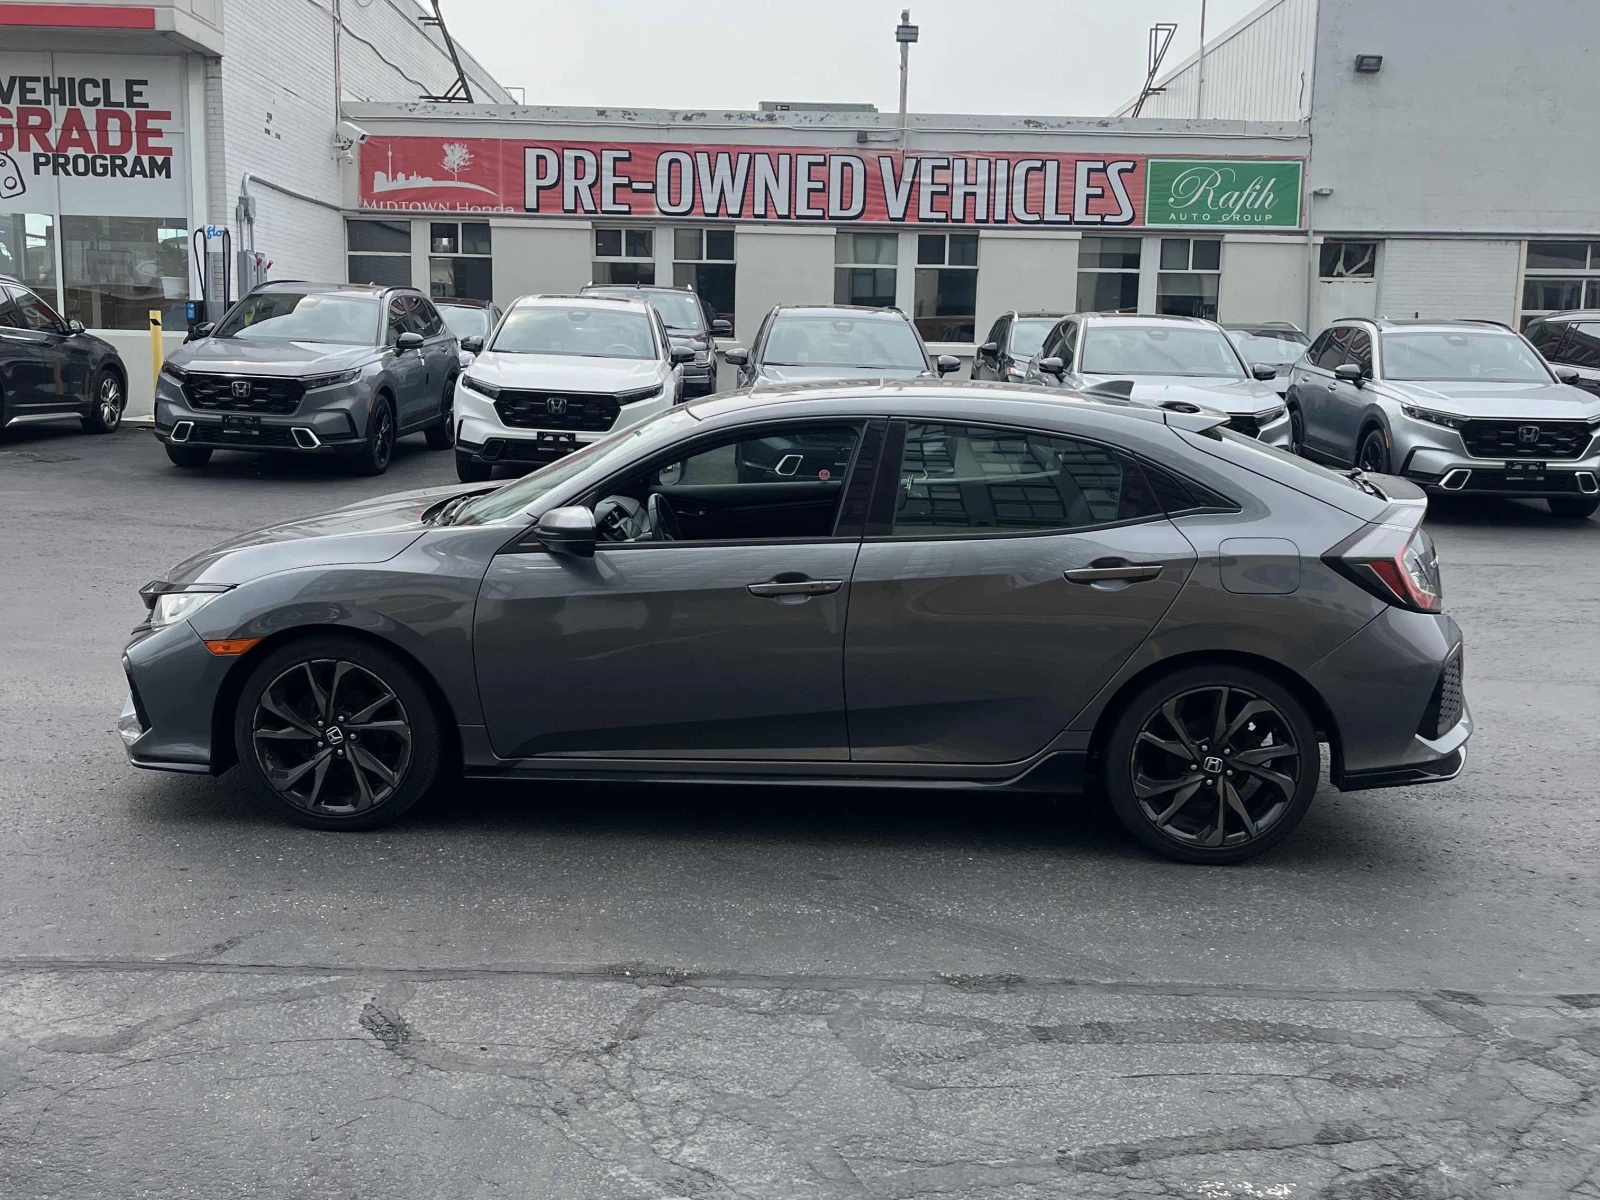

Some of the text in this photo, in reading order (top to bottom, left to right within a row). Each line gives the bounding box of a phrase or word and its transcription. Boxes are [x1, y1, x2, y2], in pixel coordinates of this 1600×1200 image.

[0, 76, 149, 108] VEHICLE
[33, 152, 172, 179] PROGRAM
[523, 146, 1137, 225] PRE-OWNED VEHICLES
[1168, 167, 1278, 222] Rafih
[456, 202, 515, 213] Honda
[1169, 213, 1273, 222] AUTO GROUP
[207, 225, 223, 240] flo
